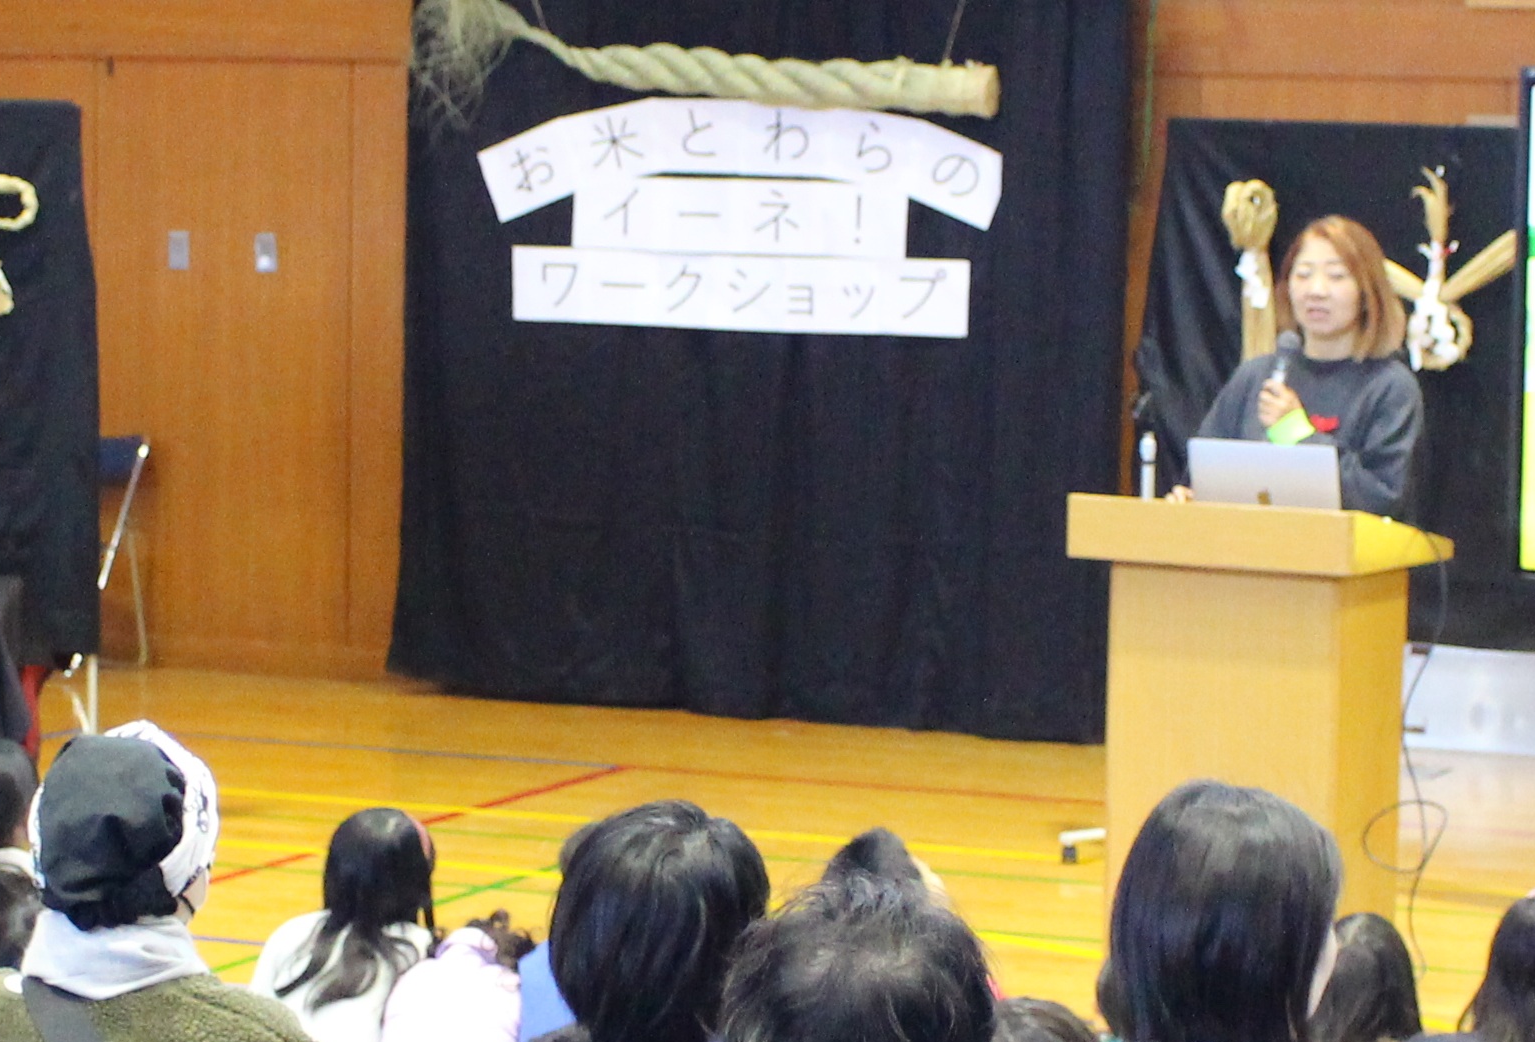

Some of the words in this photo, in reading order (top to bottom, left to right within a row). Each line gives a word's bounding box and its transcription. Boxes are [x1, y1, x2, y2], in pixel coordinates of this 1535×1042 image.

[511, 109, 979, 196] お米とわらの
[603, 188, 863, 244] イーネ！
[541, 262, 947, 319] ワークショップ
